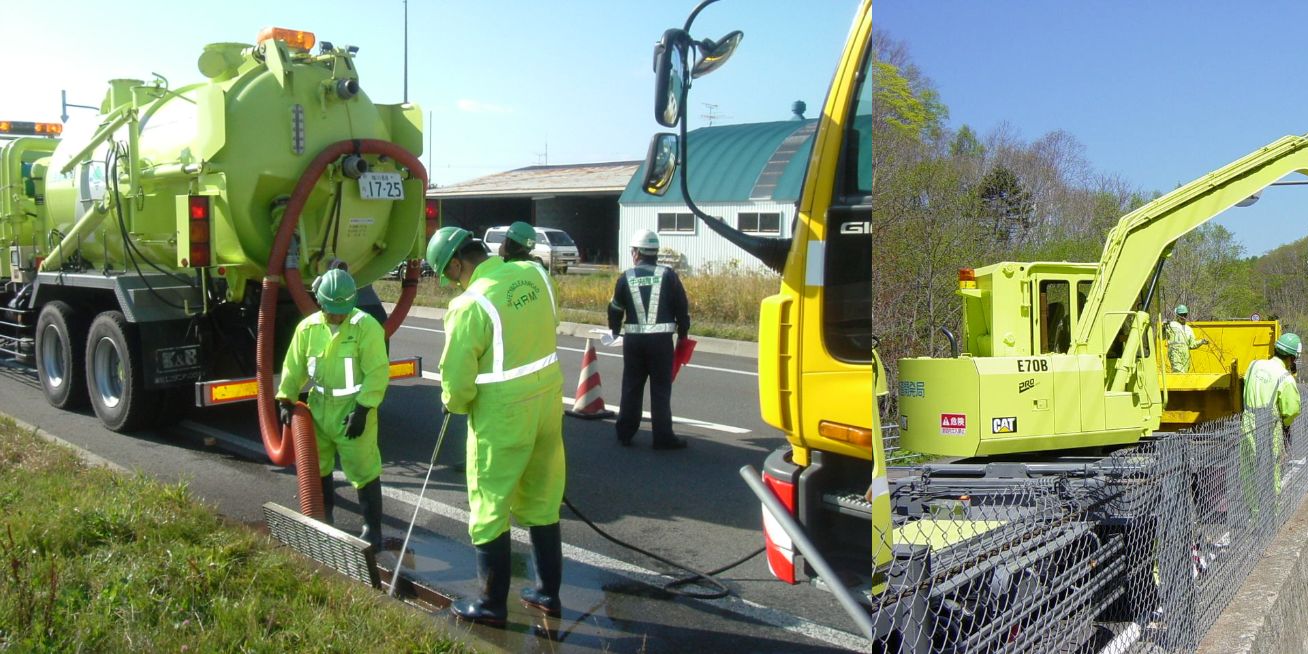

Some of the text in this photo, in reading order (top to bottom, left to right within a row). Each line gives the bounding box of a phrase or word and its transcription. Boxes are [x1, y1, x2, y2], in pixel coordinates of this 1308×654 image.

[840, 221, 872, 234] GI
[1017, 359, 1048, 372] E70B
[993, 418, 1015, 433] CAT
